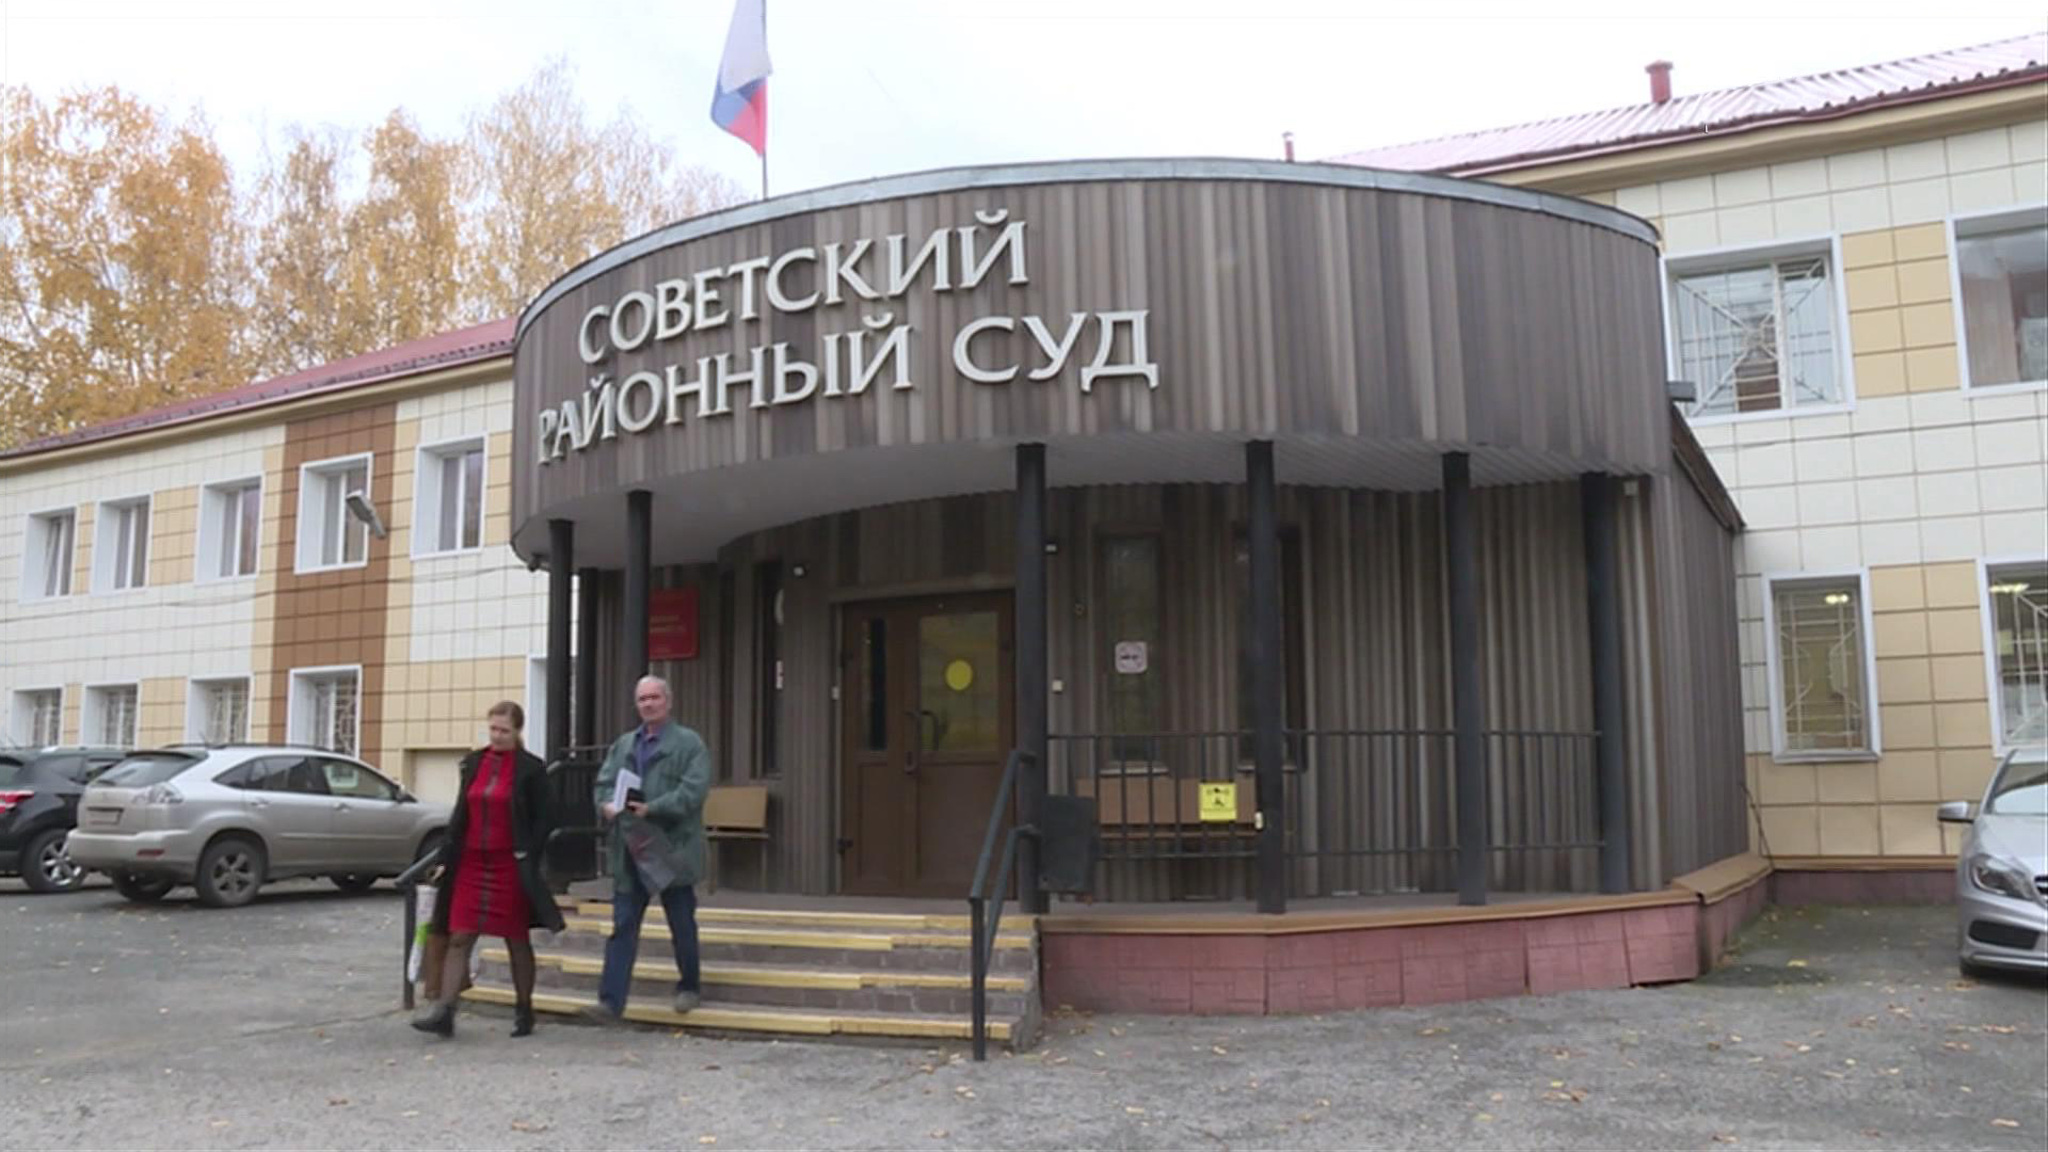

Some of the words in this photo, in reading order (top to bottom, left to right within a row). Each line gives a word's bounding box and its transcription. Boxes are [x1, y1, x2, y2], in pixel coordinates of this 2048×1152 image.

[577, 207, 1029, 365] СОВЕТСКИЙ
[537, 311, 912, 465] РАЙОННЫЙ
[952, 309, 1160, 392] СУД
